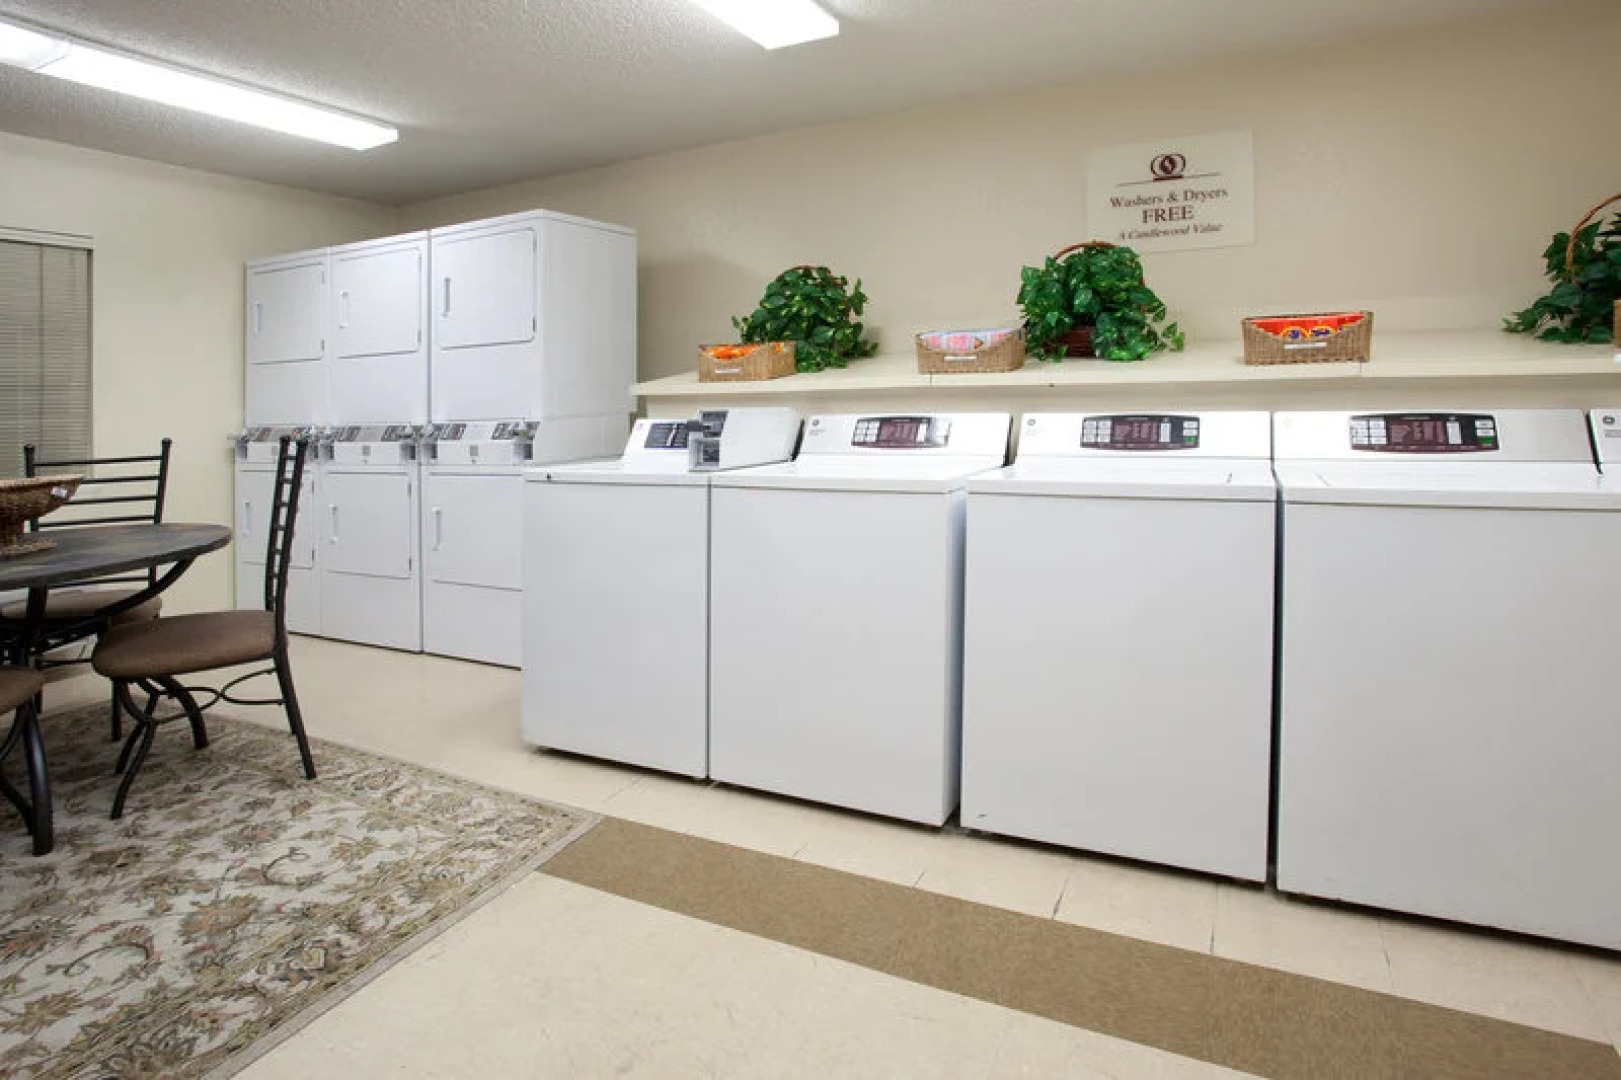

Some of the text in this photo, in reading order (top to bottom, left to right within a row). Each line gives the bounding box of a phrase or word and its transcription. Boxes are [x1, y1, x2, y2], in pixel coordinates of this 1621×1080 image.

[1110, 188, 1228, 207] Washers & Dryers
[1142, 205, 1194, 223] FREE
